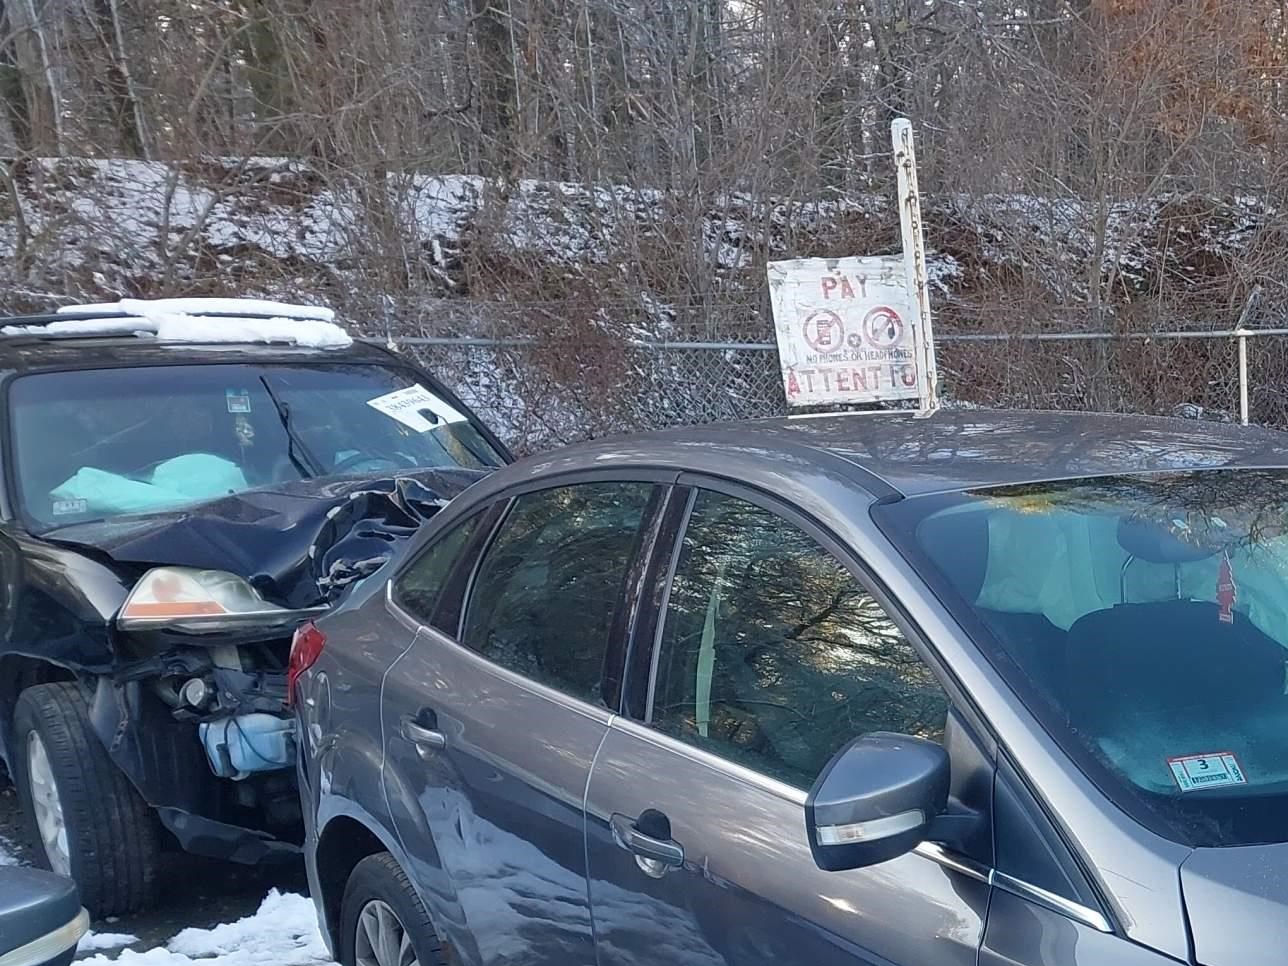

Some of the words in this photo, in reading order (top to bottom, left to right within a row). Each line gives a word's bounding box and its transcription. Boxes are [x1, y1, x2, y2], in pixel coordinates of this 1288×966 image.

[821, 275, 867, 300] PAY
[851, 351, 862, 361] OR
[1198, 759, 1209, 770] 3
